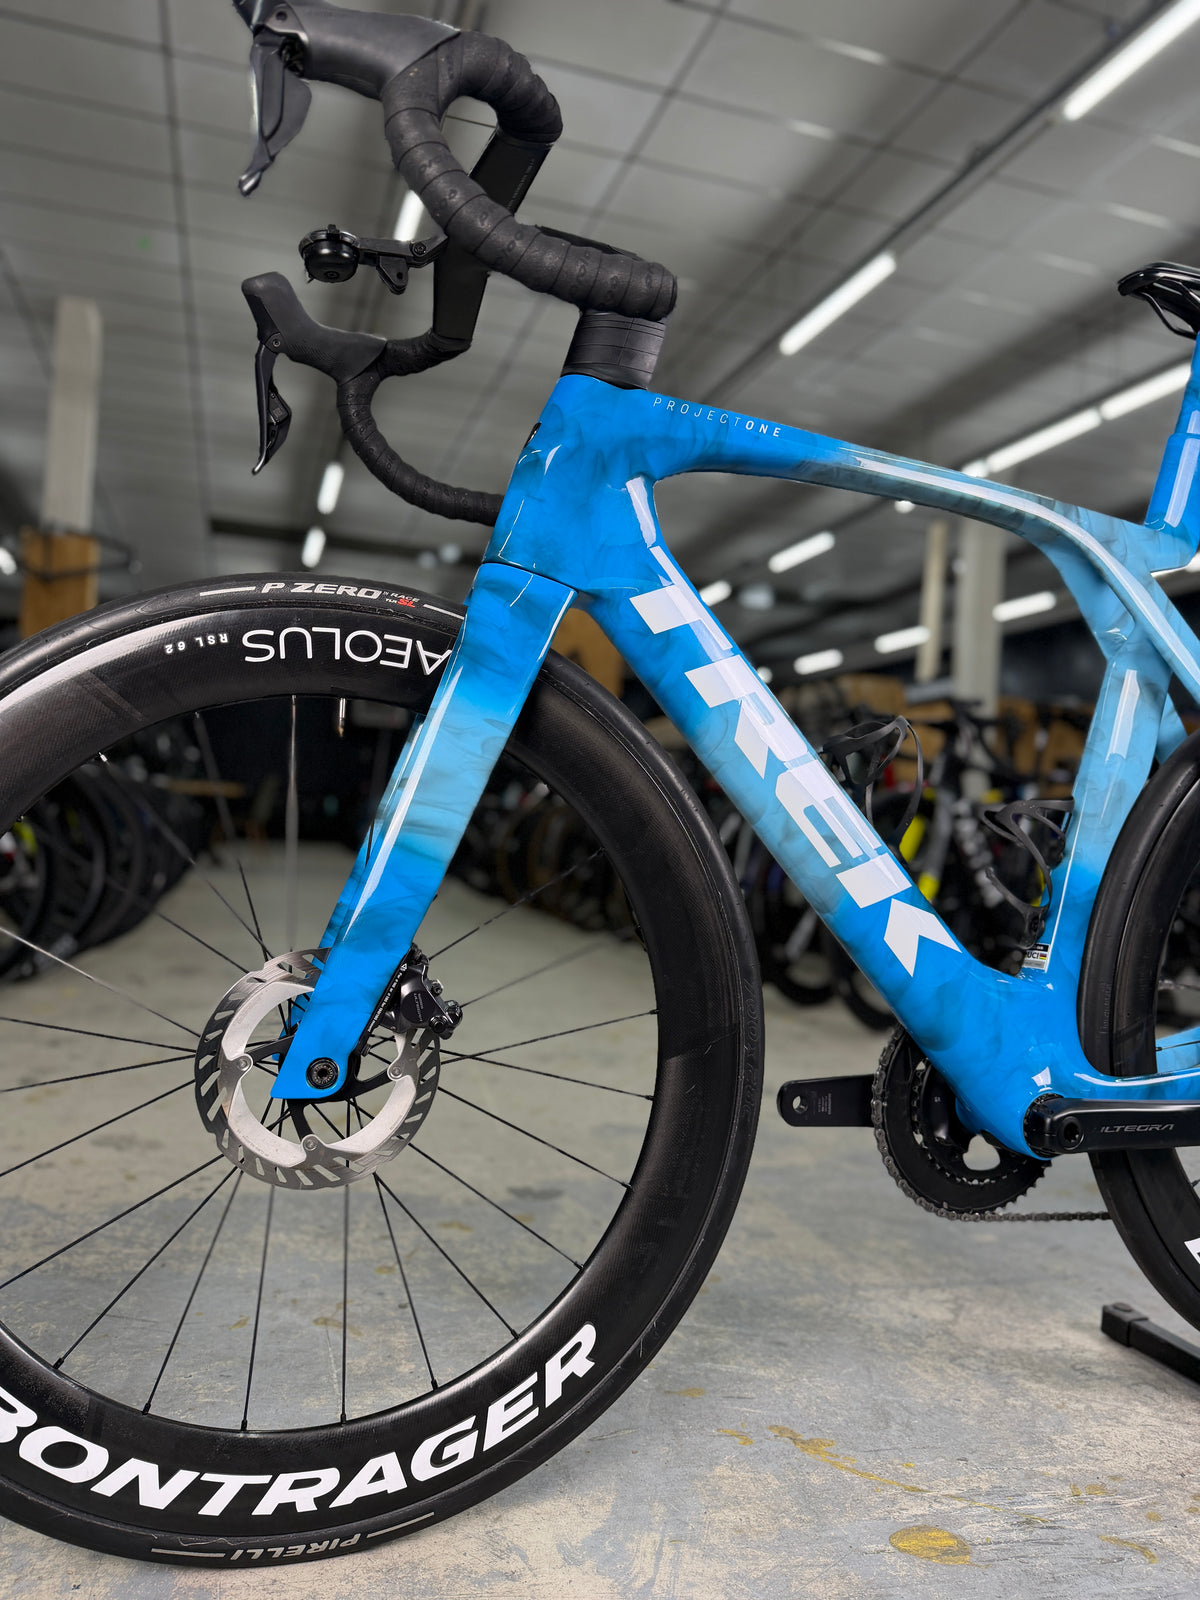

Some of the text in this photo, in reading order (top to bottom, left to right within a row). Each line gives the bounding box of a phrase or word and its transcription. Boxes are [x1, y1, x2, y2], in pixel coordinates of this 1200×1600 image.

[261, 582, 420, 603] P ZERO RACE
[397, 598, 416, 608] SL
[165, 627, 452, 676] AEOLUS RSL 62
[629, 546, 962, 977] TREK
[230, 1533, 362, 1561] PIRELLI
